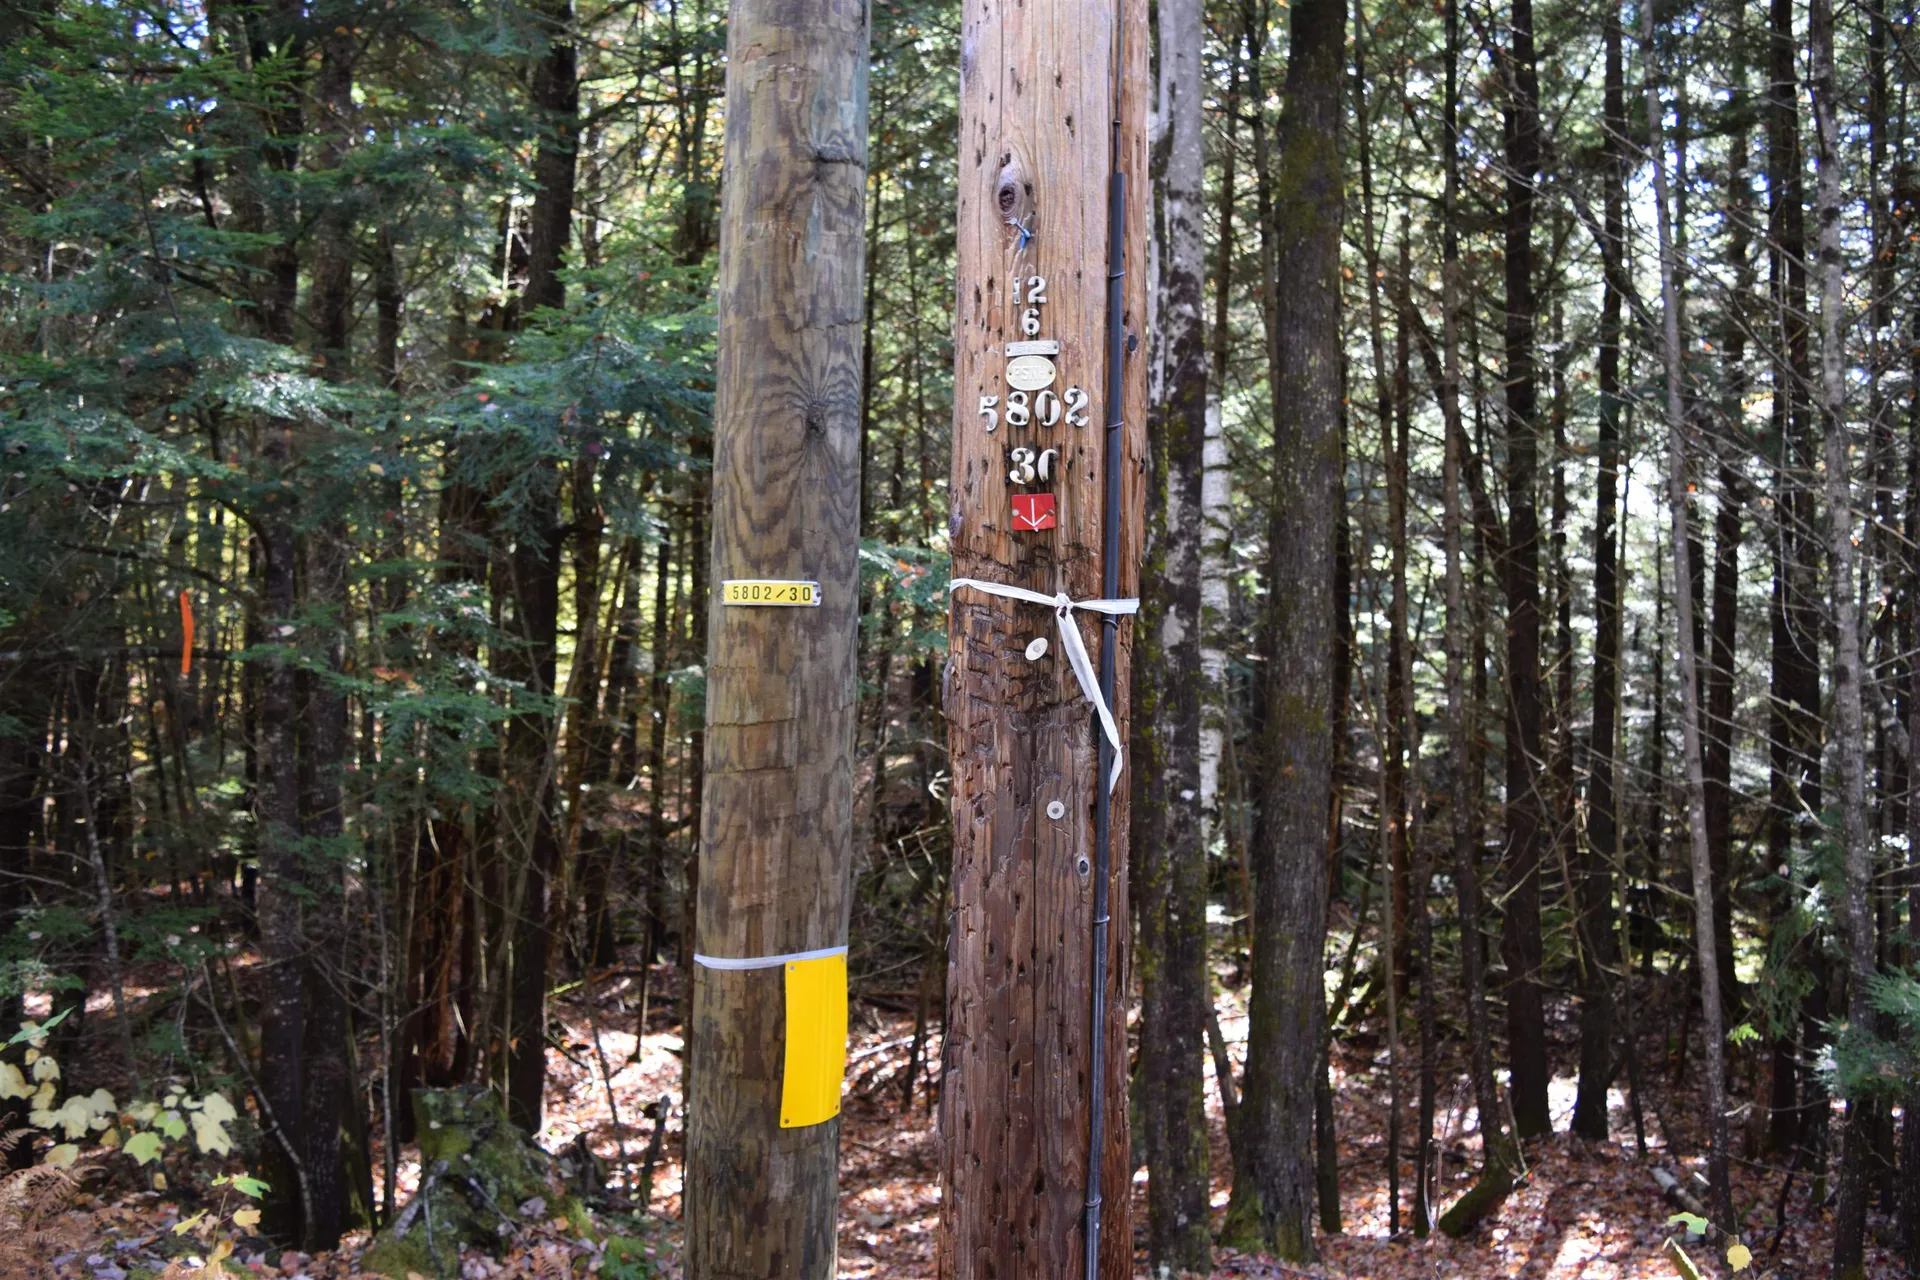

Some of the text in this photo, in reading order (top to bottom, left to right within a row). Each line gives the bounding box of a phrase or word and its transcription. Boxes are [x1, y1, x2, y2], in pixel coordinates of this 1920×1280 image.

[1022, 308, 1040, 336] 6
[979, 388, 1089, 432] 5802
[732, 585, 811, 601] 5802/30
